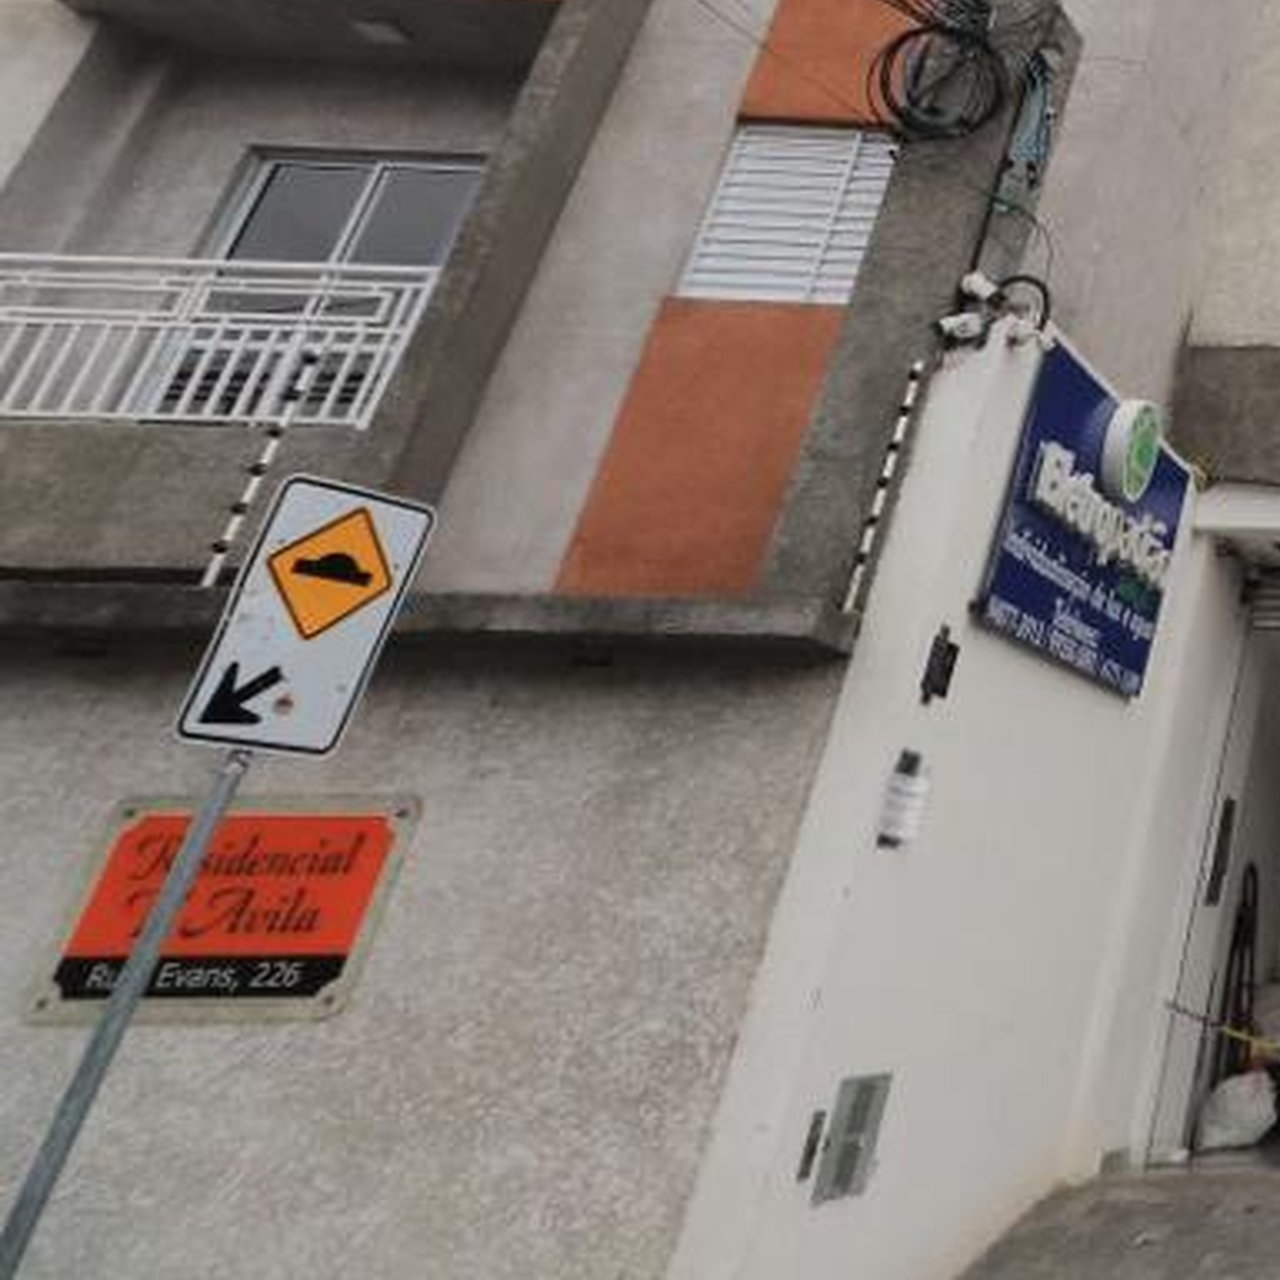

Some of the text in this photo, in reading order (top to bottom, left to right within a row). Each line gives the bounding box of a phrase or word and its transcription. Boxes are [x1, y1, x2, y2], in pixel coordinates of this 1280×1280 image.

[128, 832, 366, 880] Rsidencial
[127, 885, 320, 939] Avila
[85, 962, 303, 992] Ru Evans, 226
